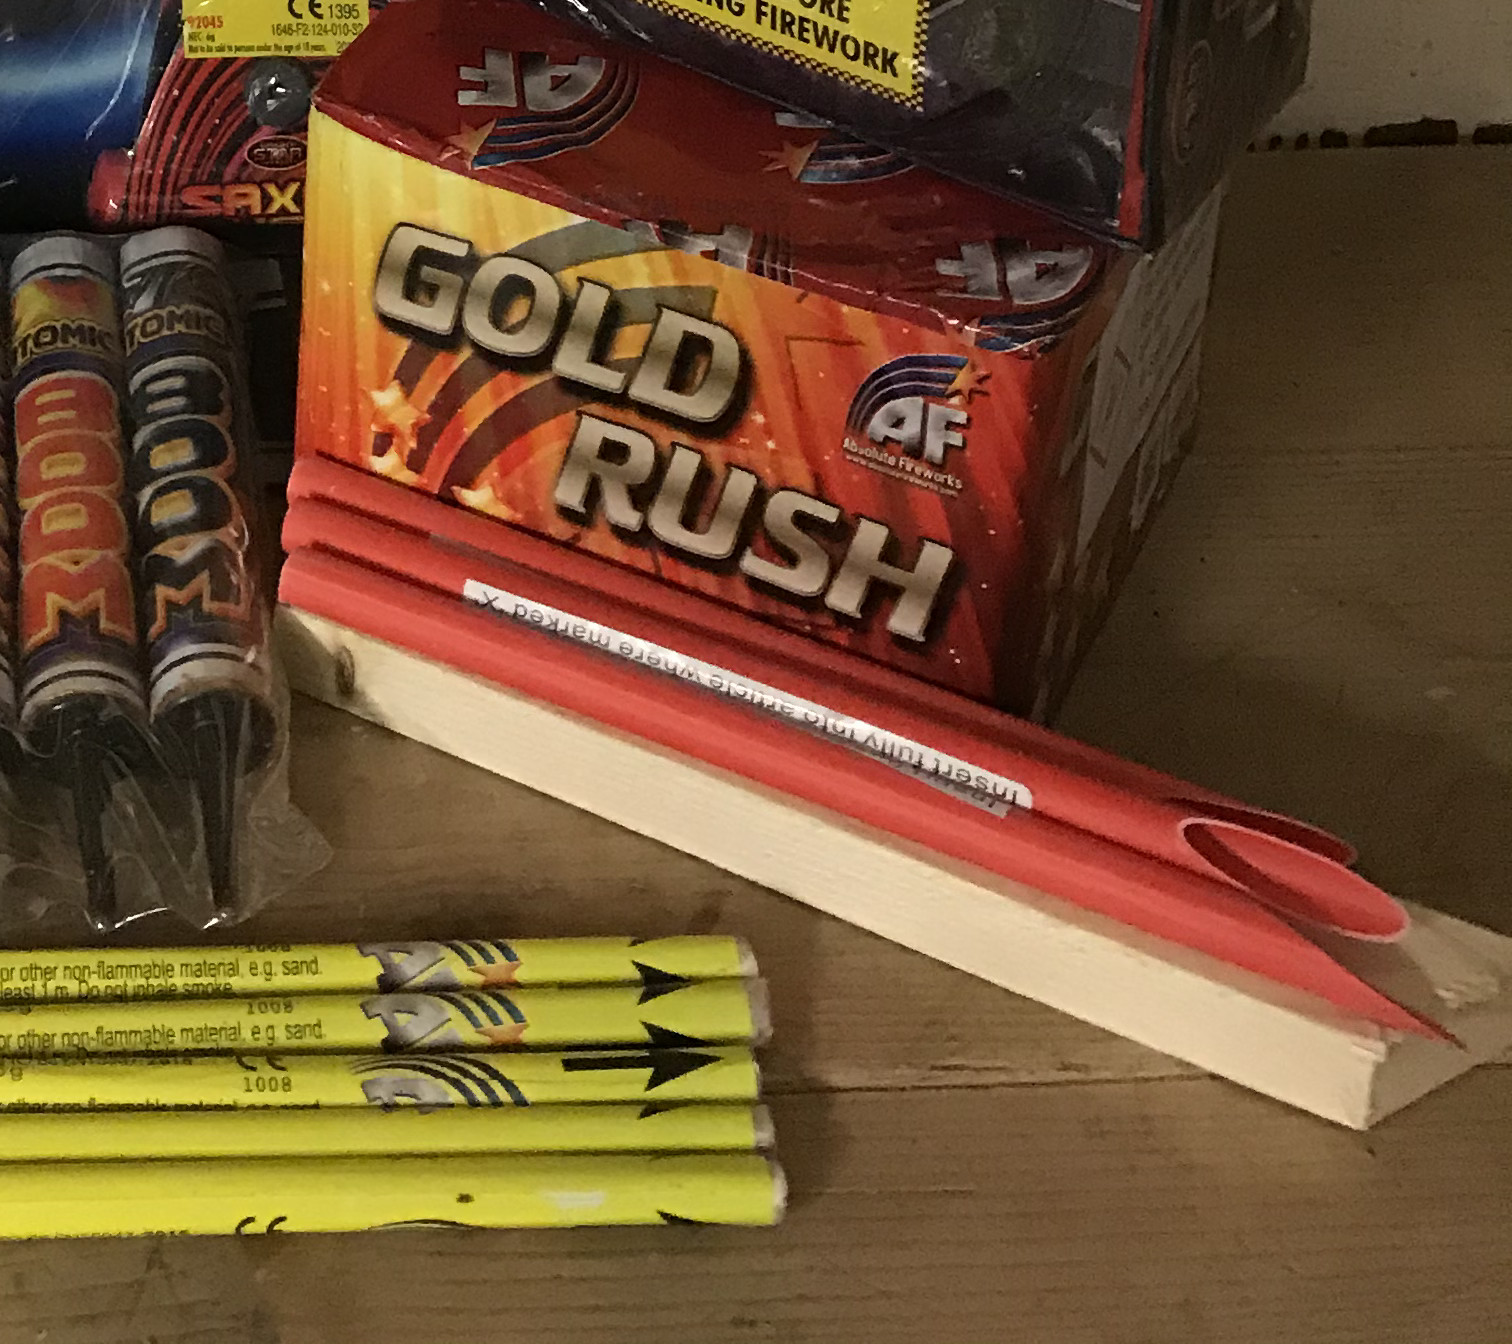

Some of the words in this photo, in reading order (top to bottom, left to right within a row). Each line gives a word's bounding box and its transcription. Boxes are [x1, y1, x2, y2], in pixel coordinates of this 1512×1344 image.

[328, 3, 360, 20] 1395
[181, 181, 301, 216] SAX
[373, 221, 745, 426] GOLD
[868, 395, 969, 465] AF
[899, 456, 963, 490] Fireworks
[553, 410, 956, 643] RUSH
[511, 602, 614, 653] marked
[932, 758, 1018, 807] Insert
[0, 968, 16, 981] or
[20, 963, 59, 981] other
[63, 960, 175, 983] non-flammable
[281, 956, 324, 976] sand.
[62, 1024, 176, 1052] non-flammable
[244, 1076, 292, 1093] 1008
